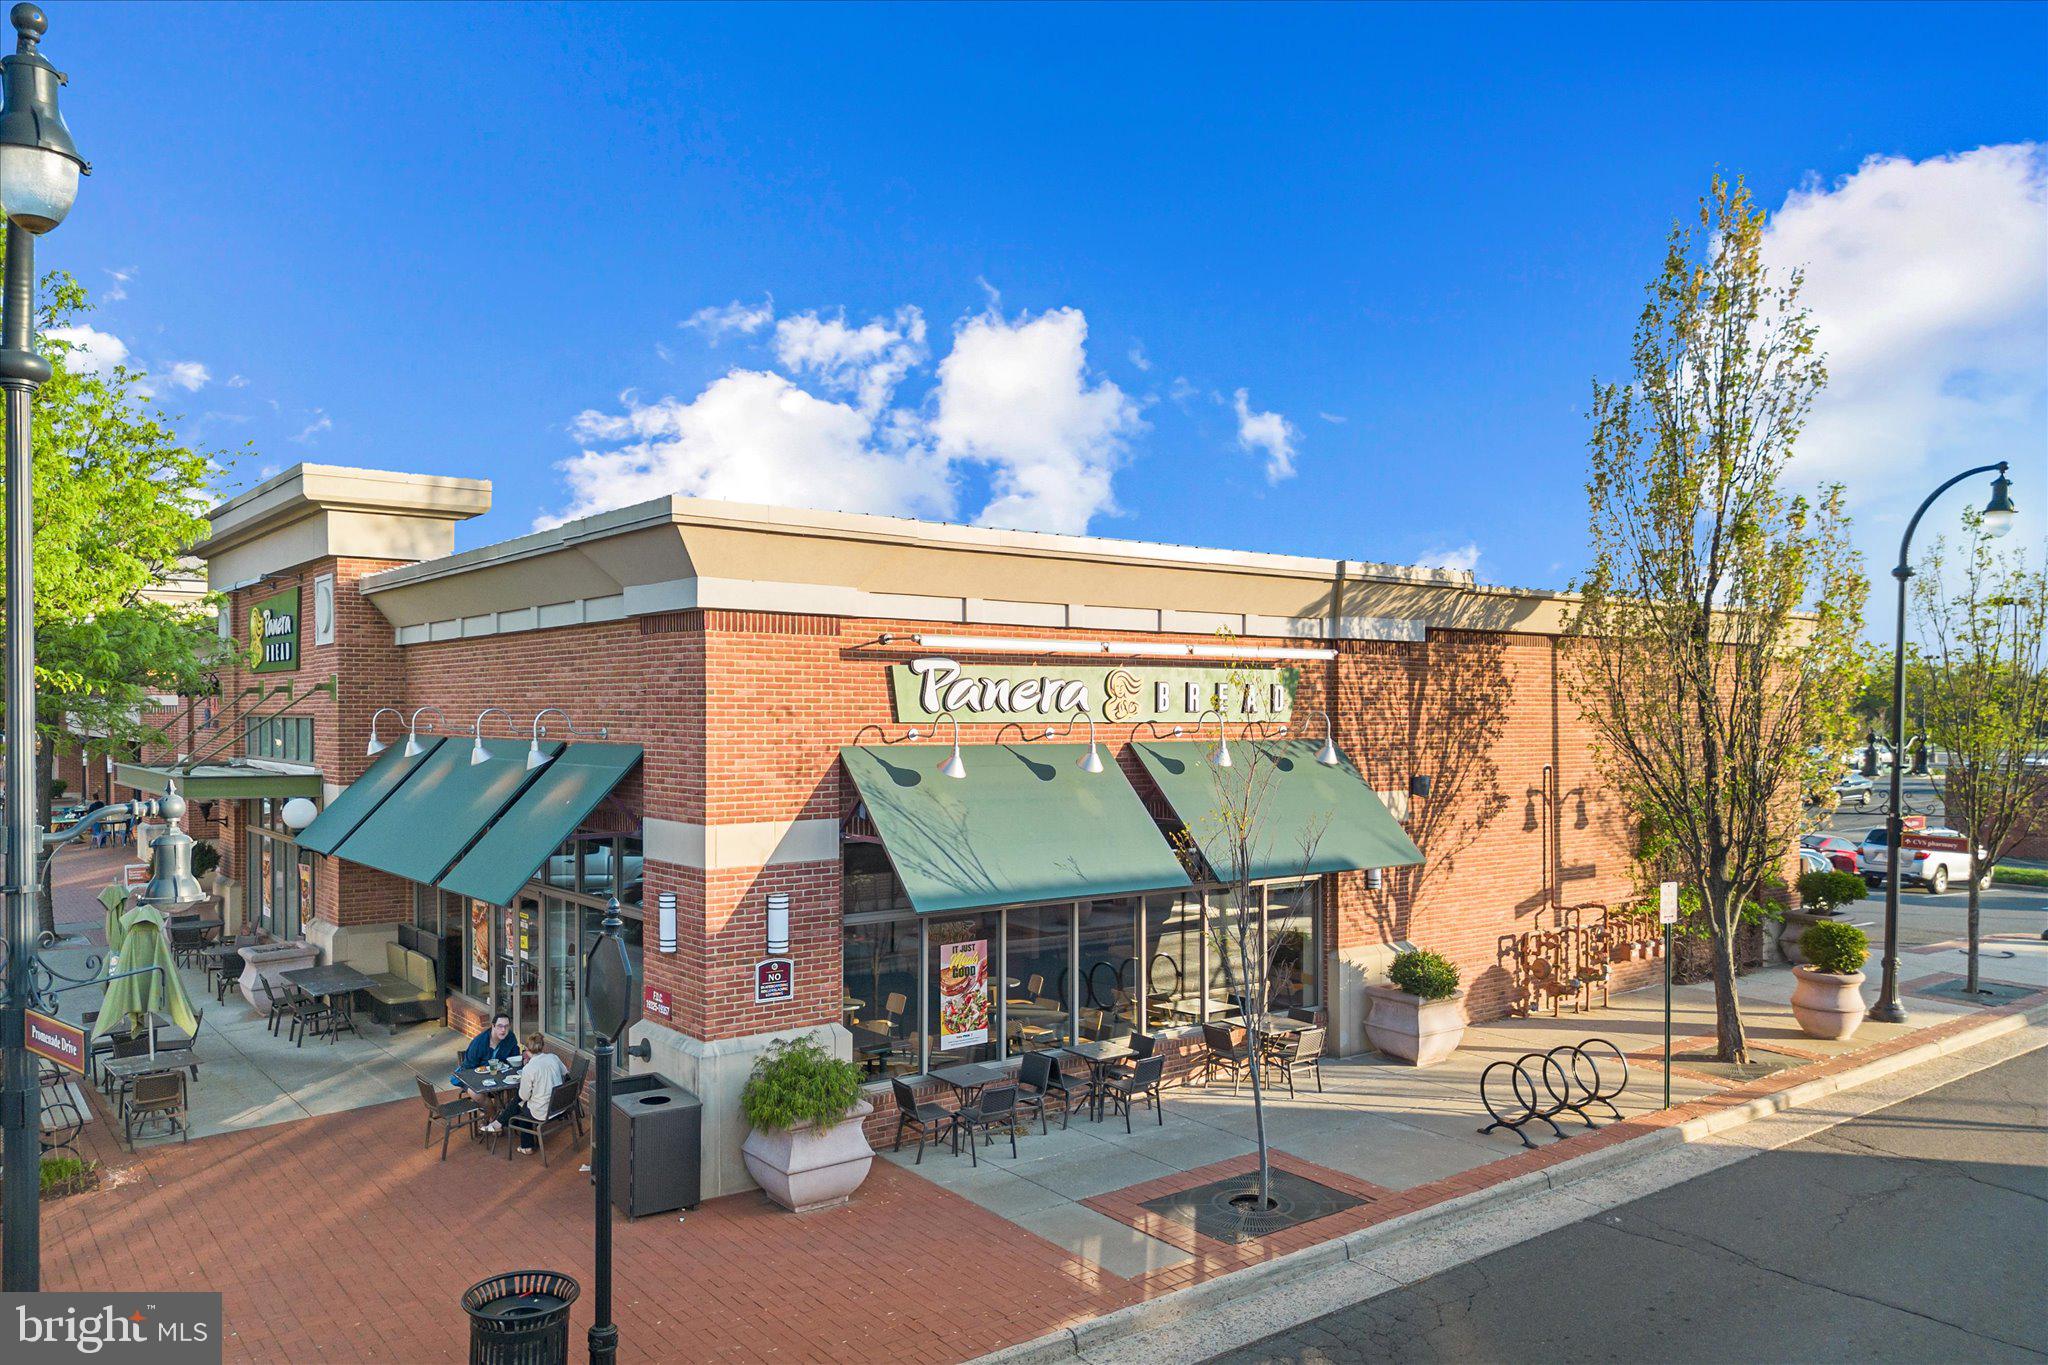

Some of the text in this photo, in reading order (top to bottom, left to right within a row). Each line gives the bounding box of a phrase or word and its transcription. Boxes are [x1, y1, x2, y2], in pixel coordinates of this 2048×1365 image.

[263, 609, 292, 637] Panera
[908, 657, 1285, 714] Panera BREAD
[952, 943, 976, 954] IT JUST
[768, 972, 782, 982] NO
[952, 965, 976, 979] GOOD
[31, 1024, 77, 1056] Promenade Drive
